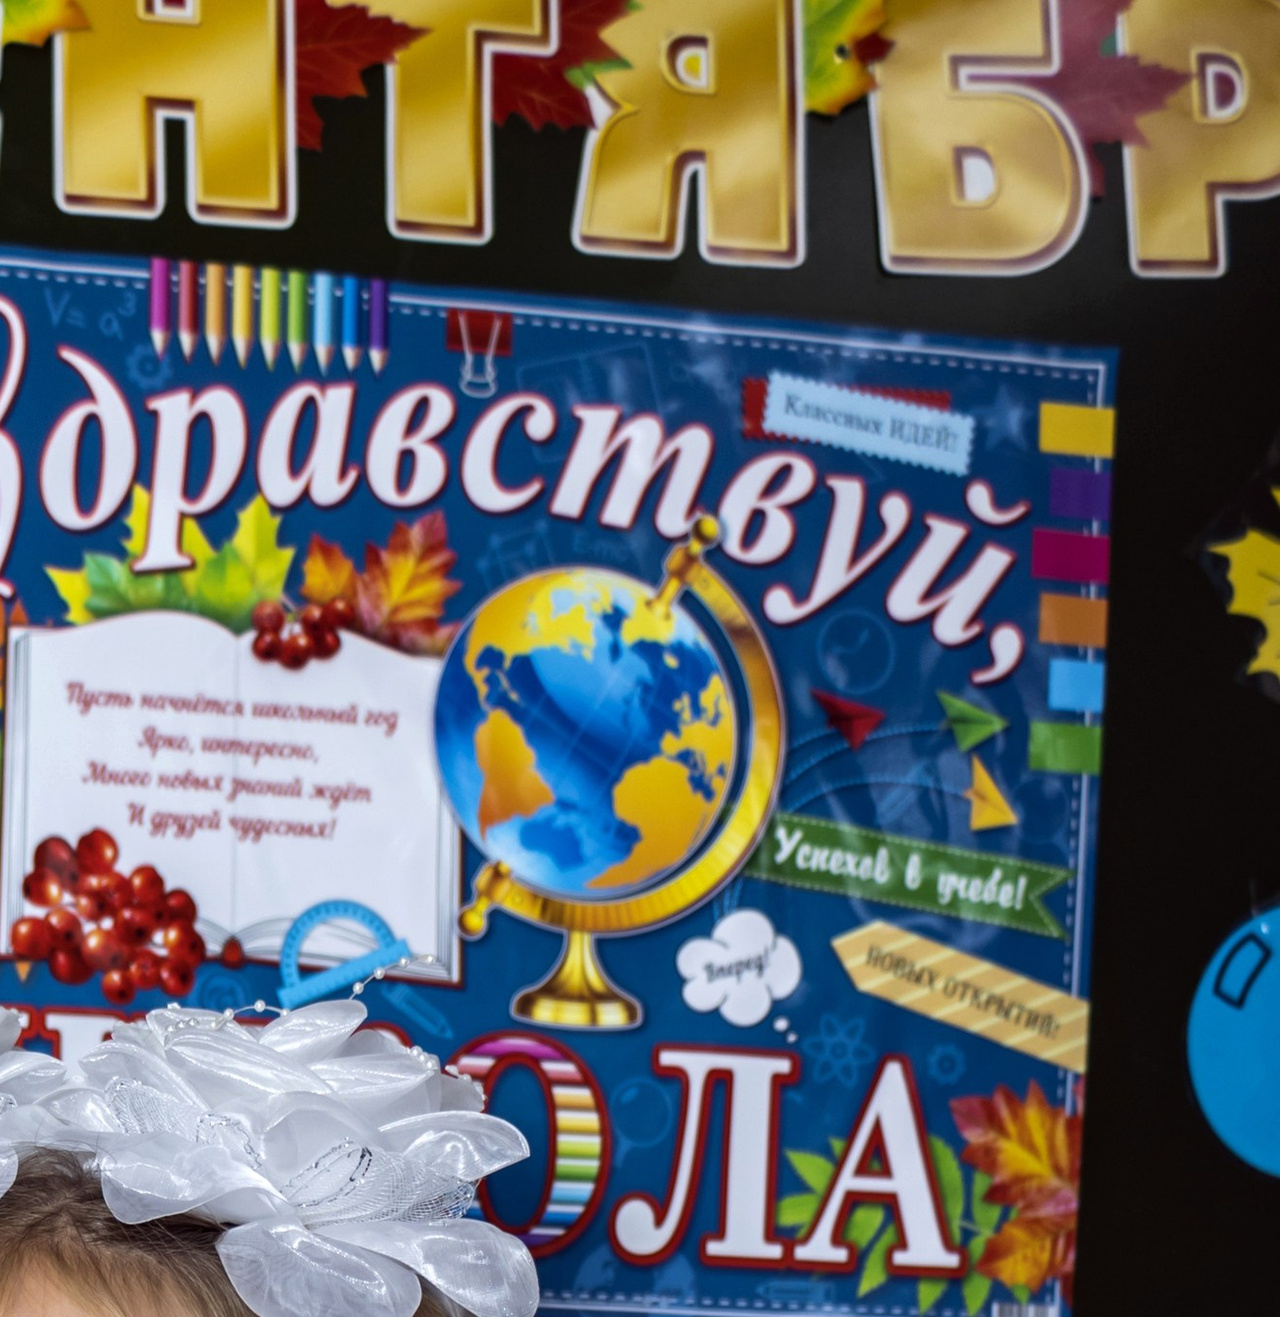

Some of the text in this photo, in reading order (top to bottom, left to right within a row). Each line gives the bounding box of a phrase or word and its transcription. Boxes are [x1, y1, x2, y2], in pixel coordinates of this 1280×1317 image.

[67, 681, 399, 737] Пусть начнётся школьный год
[138, 725, 319, 766] Ярко, интересно,
[82, 760, 372, 810] Много новых знаний ждёт
[126, 802, 337, 843] И друзей чудесных!
[774, 825, 890, 885] Успехов
[904, 853, 922, 891] в
[866, 945, 1061, 1041] НОВЫХ ОТКРЫТИЙ!
